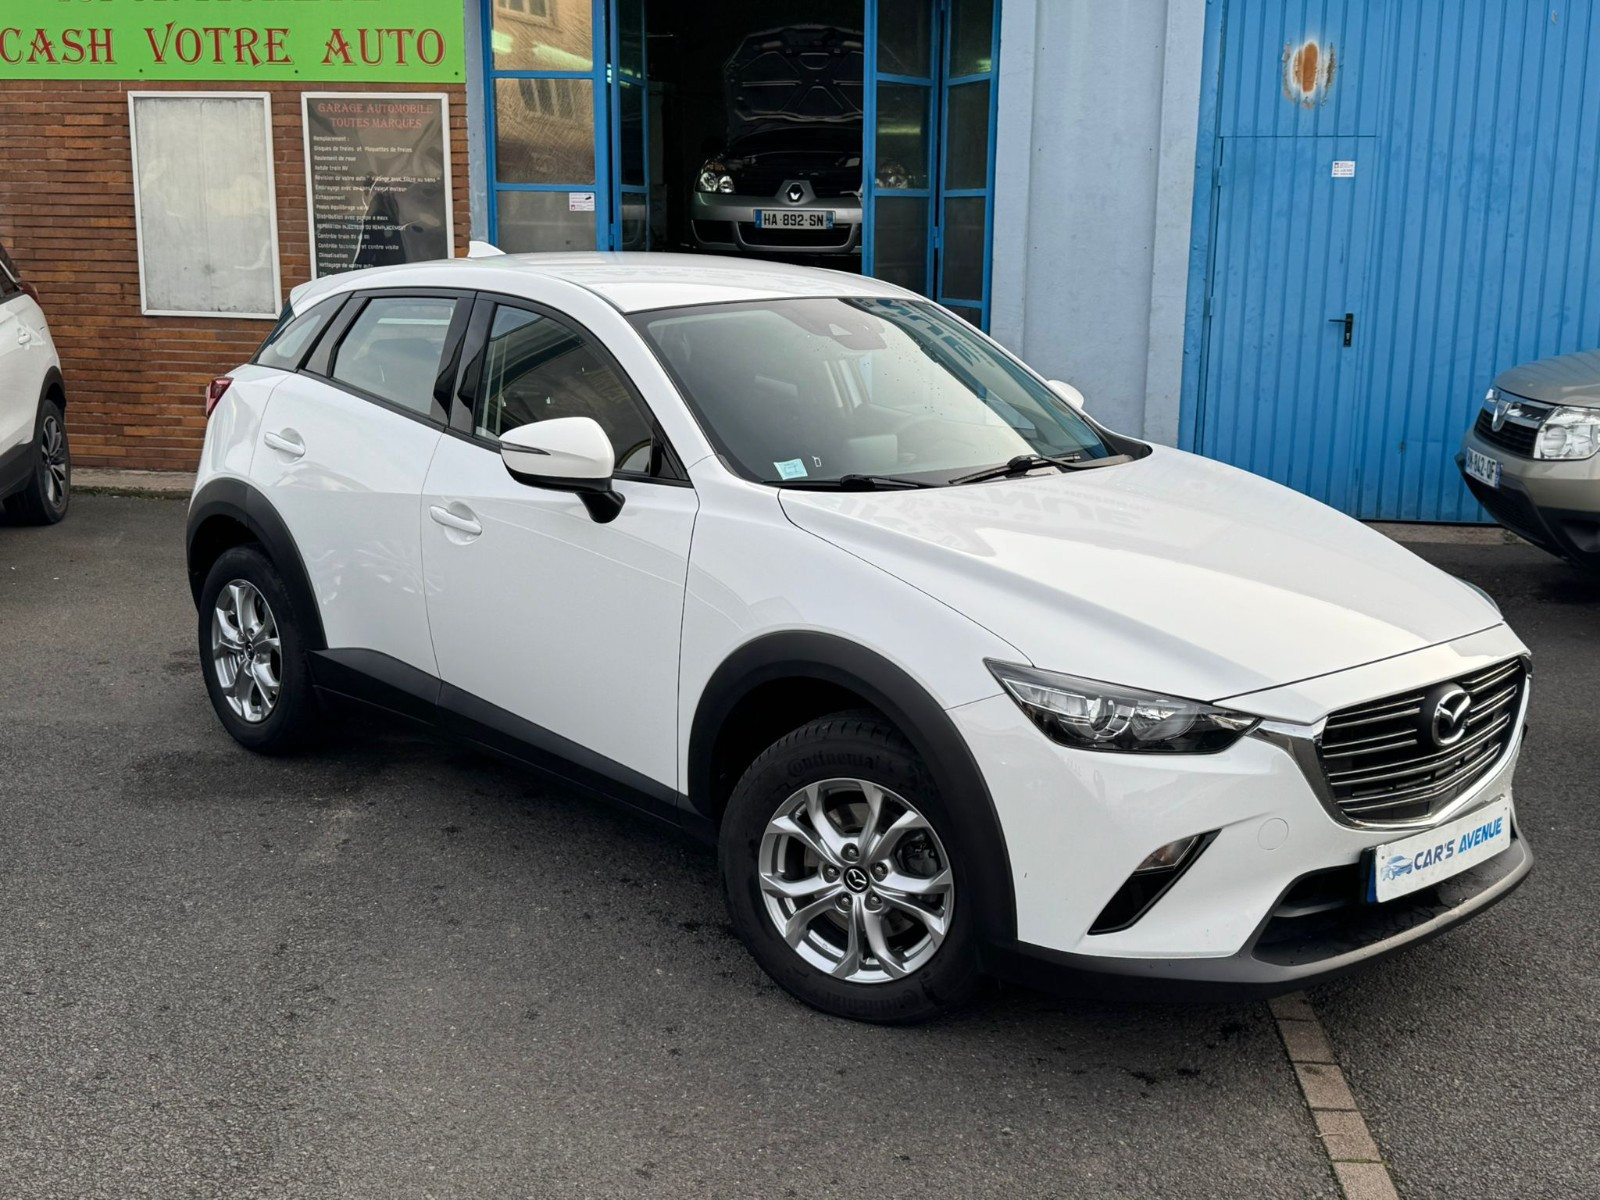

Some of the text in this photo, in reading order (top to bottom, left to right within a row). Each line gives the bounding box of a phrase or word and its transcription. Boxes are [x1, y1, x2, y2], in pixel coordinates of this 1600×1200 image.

[0, 20, 446, 68] CASH VOTRE AUTO
[318, 103, 434, 114] GARAGE AUTOMOBILE
[330, 117, 422, 129] TOUTES MARQUES
[1414, 816, 1503, 871] CAR'S AVENUE
